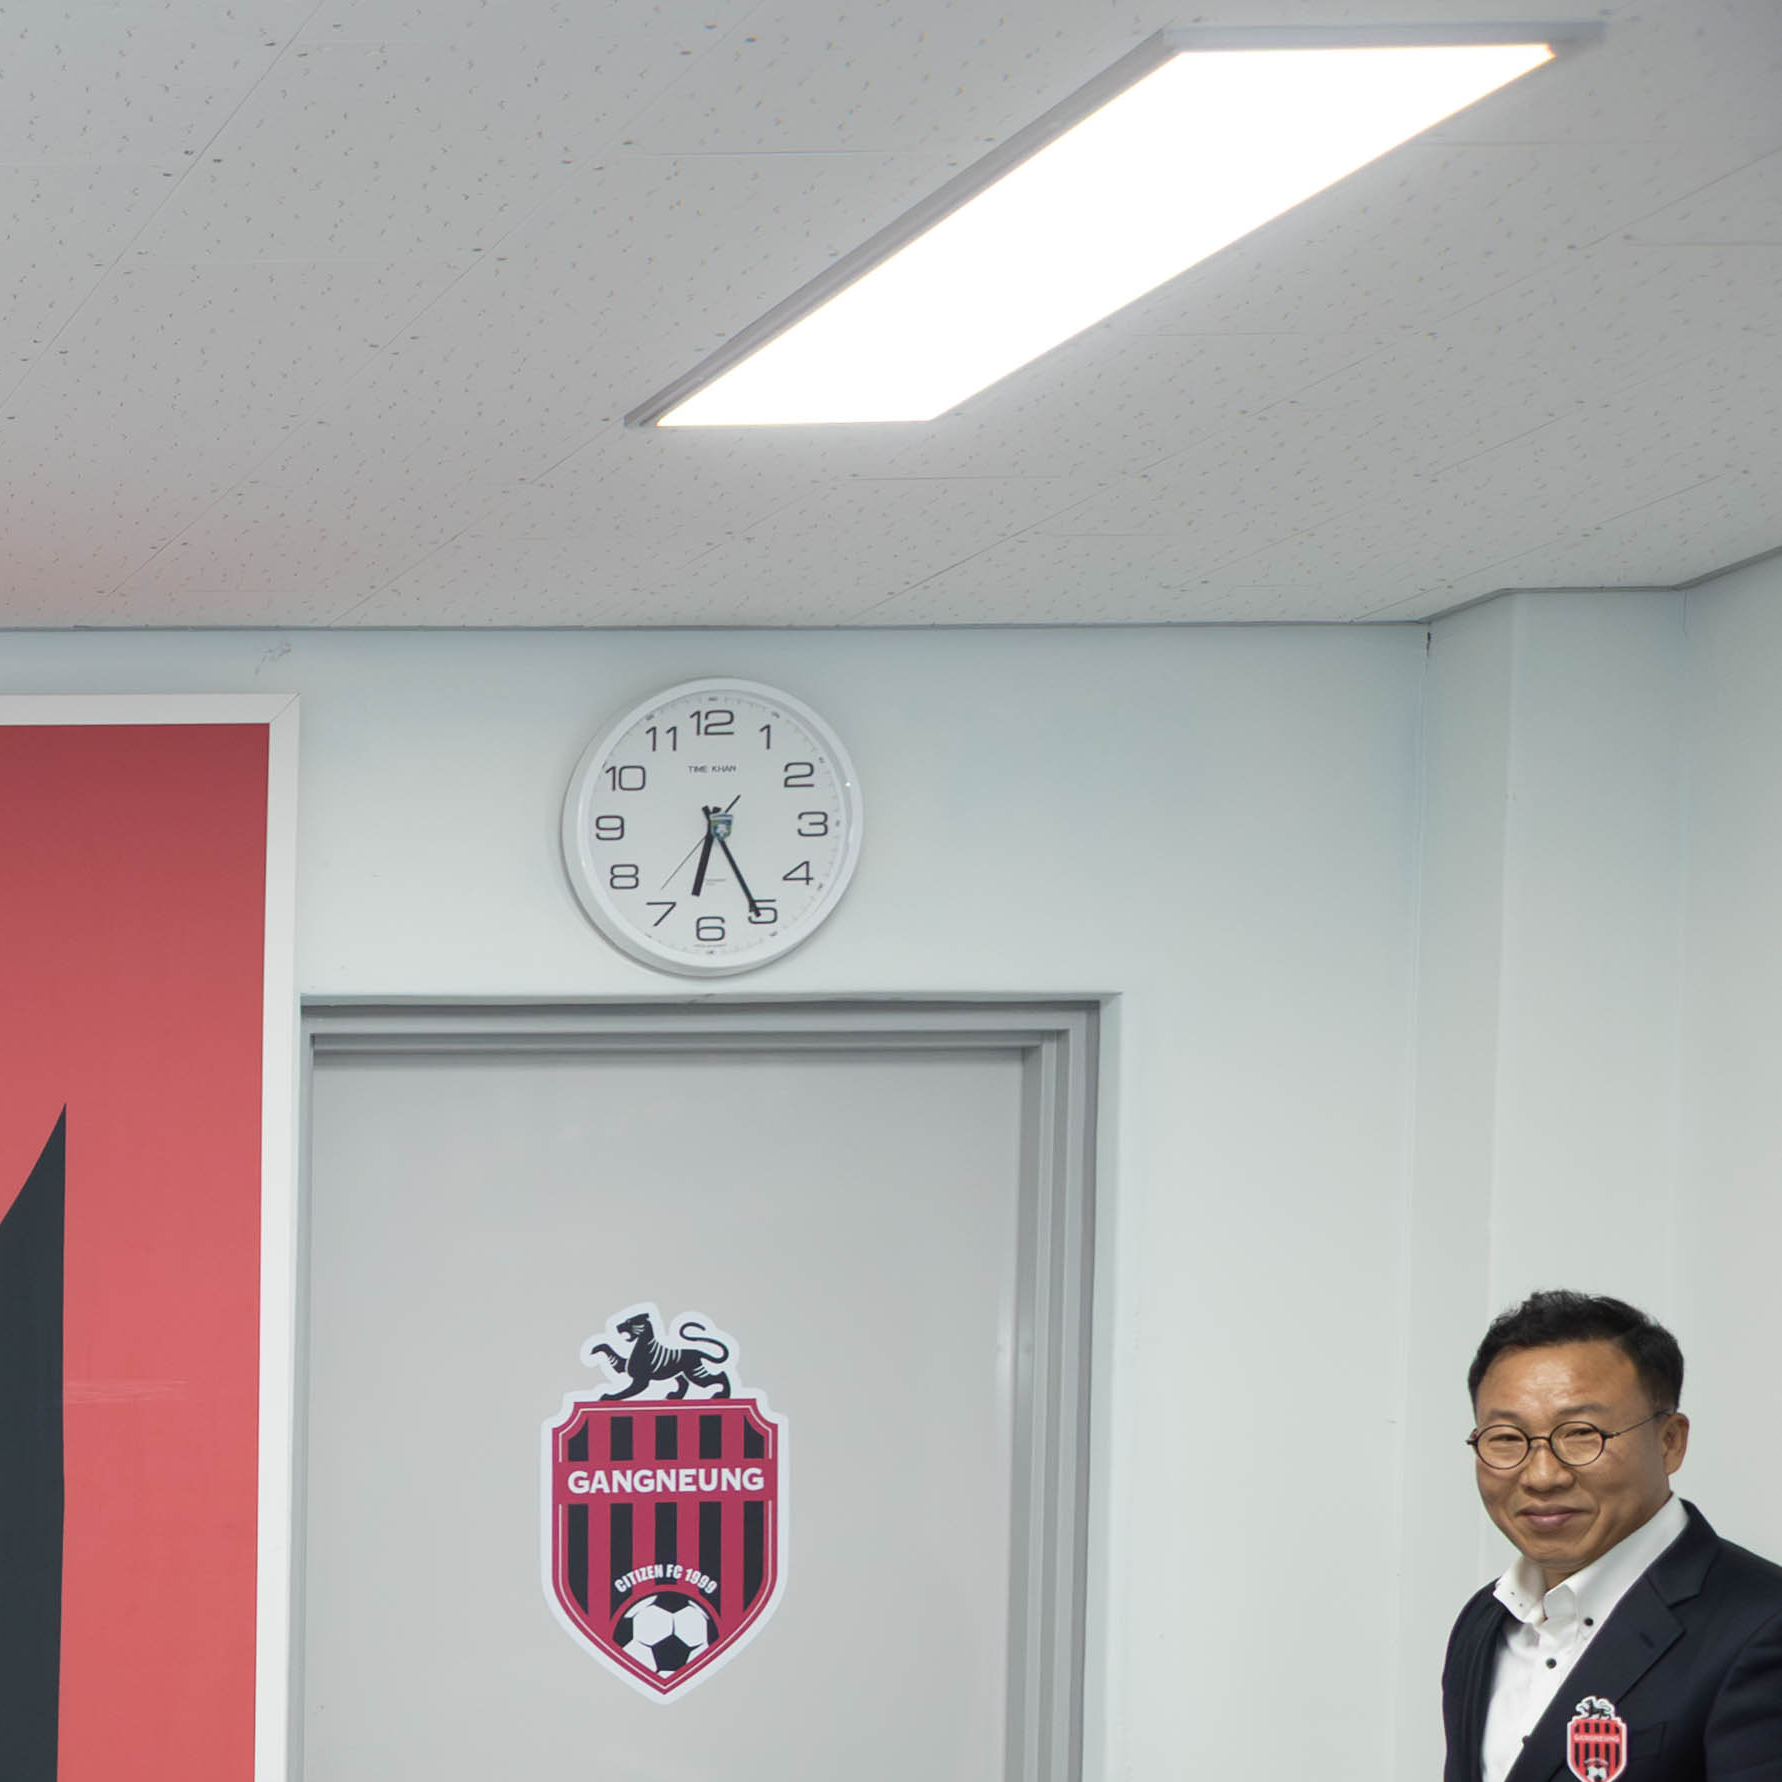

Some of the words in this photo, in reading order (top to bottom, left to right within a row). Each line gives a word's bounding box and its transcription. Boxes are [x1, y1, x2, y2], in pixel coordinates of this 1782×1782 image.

[690, 709, 735, 736] 12
[645, 726, 678, 752] 11
[759, 724, 771, 750] 1
[605, 765, 646, 792] 10
[783, 762, 815, 788] 2
[595, 815, 625, 841] 9
[797, 811, 829, 837] 3
[609, 864, 639, 890] 8
[782, 860, 814, 886] 4
[646, 901, 677, 927] 7
[748, 898, 778, 925] 5
[696, 916, 726, 942] 6
[567, 1467, 764, 1494] GANGNEUNG
[614, 1564, 664, 1593] CITIZEN
[665, 1564, 683, 1579] FC
[684, 1568, 718, 1594] 1999
